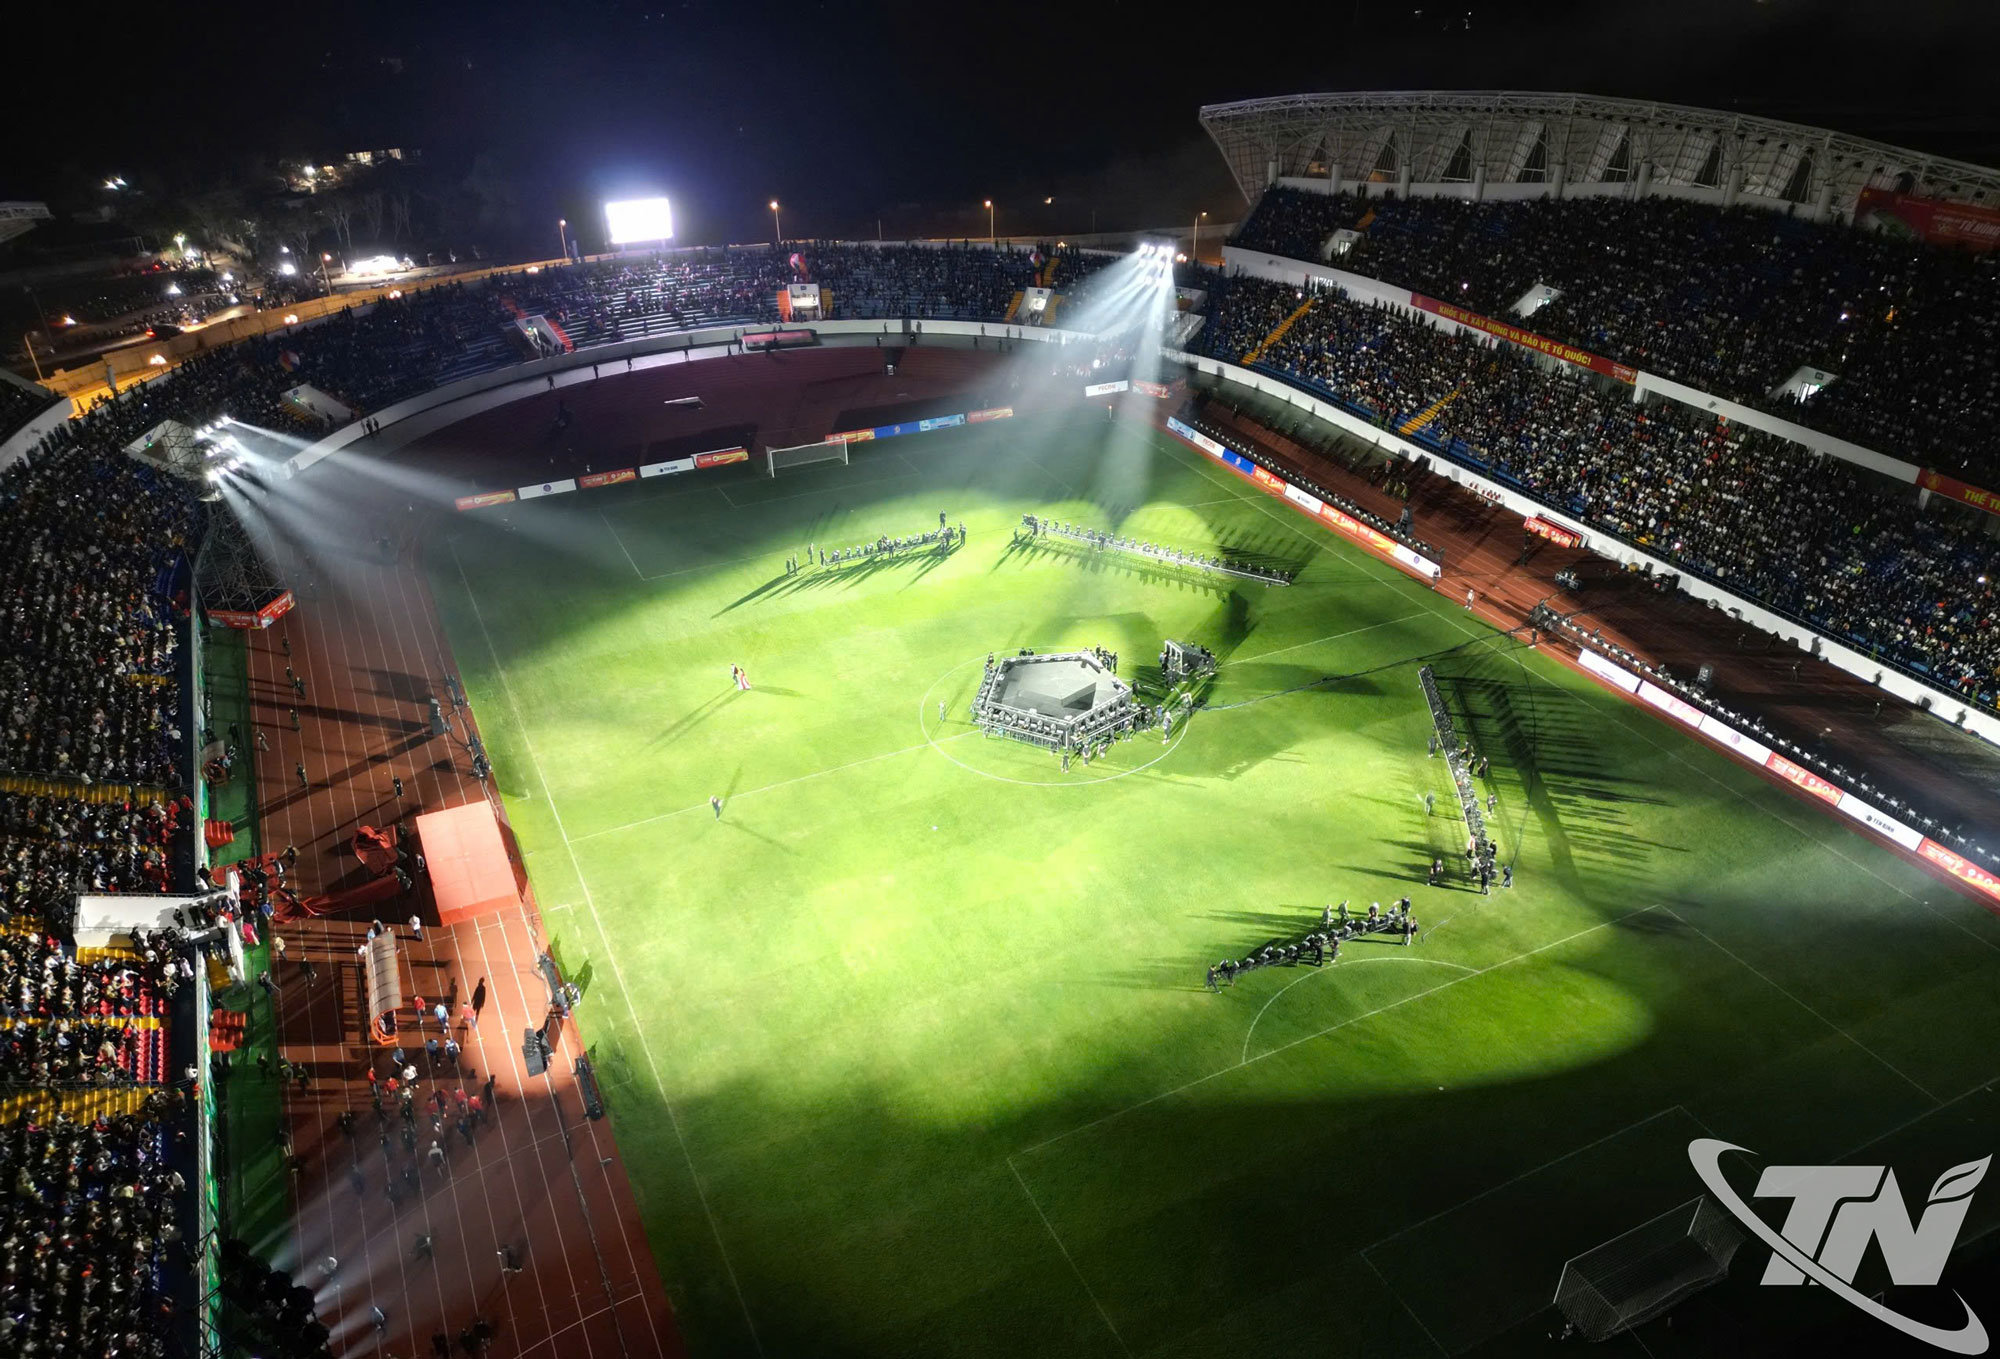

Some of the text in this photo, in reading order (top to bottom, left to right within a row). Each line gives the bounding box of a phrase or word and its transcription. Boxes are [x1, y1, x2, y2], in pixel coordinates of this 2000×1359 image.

[1471, 315, 1486, 329] XÂY
[1510, 328, 1520, 341] VÀ
[1521, 334, 1539, 347] BẢO
[1540, 341, 1551, 352] VỆ
[1564, 350, 1592, 365] QUỐC!
